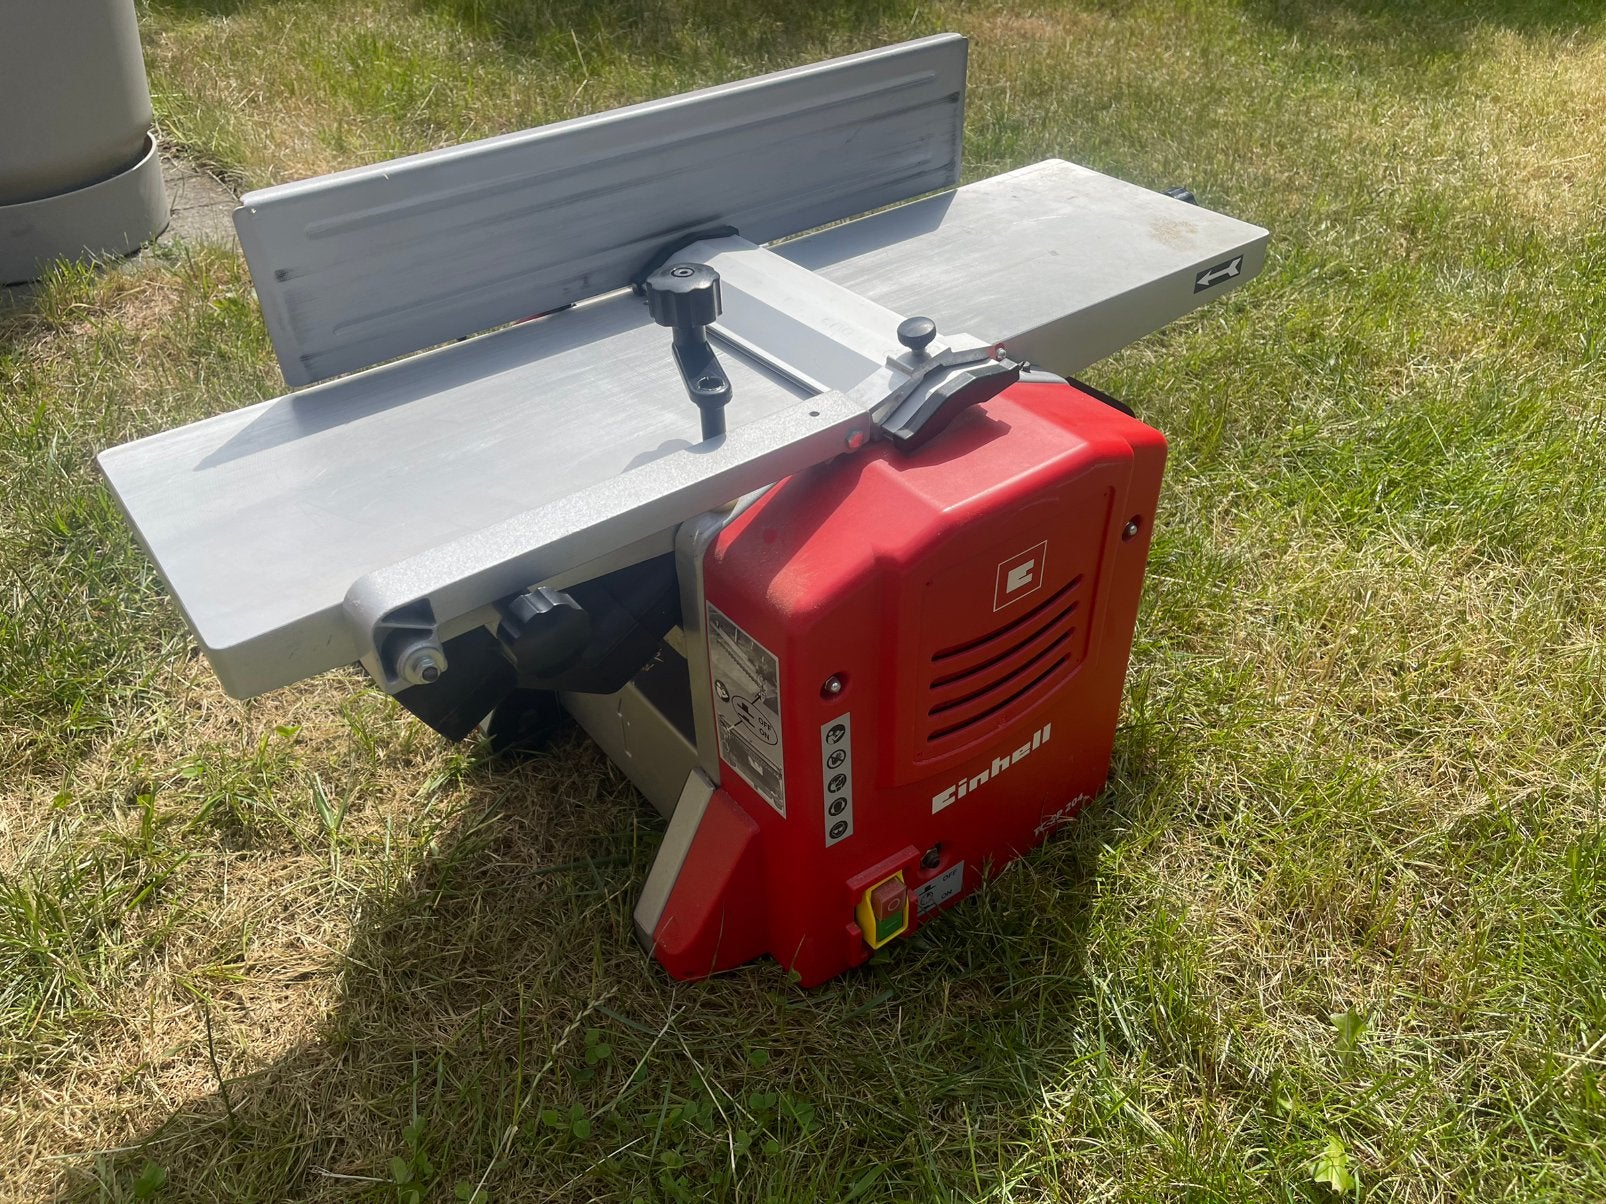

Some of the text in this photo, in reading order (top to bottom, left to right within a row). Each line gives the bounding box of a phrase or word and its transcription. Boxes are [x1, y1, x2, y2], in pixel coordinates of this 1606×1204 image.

[758, 717, 772, 731] OFF
[759, 728, 771, 741] ON
[931, 722, 1052, 815] Einhell
